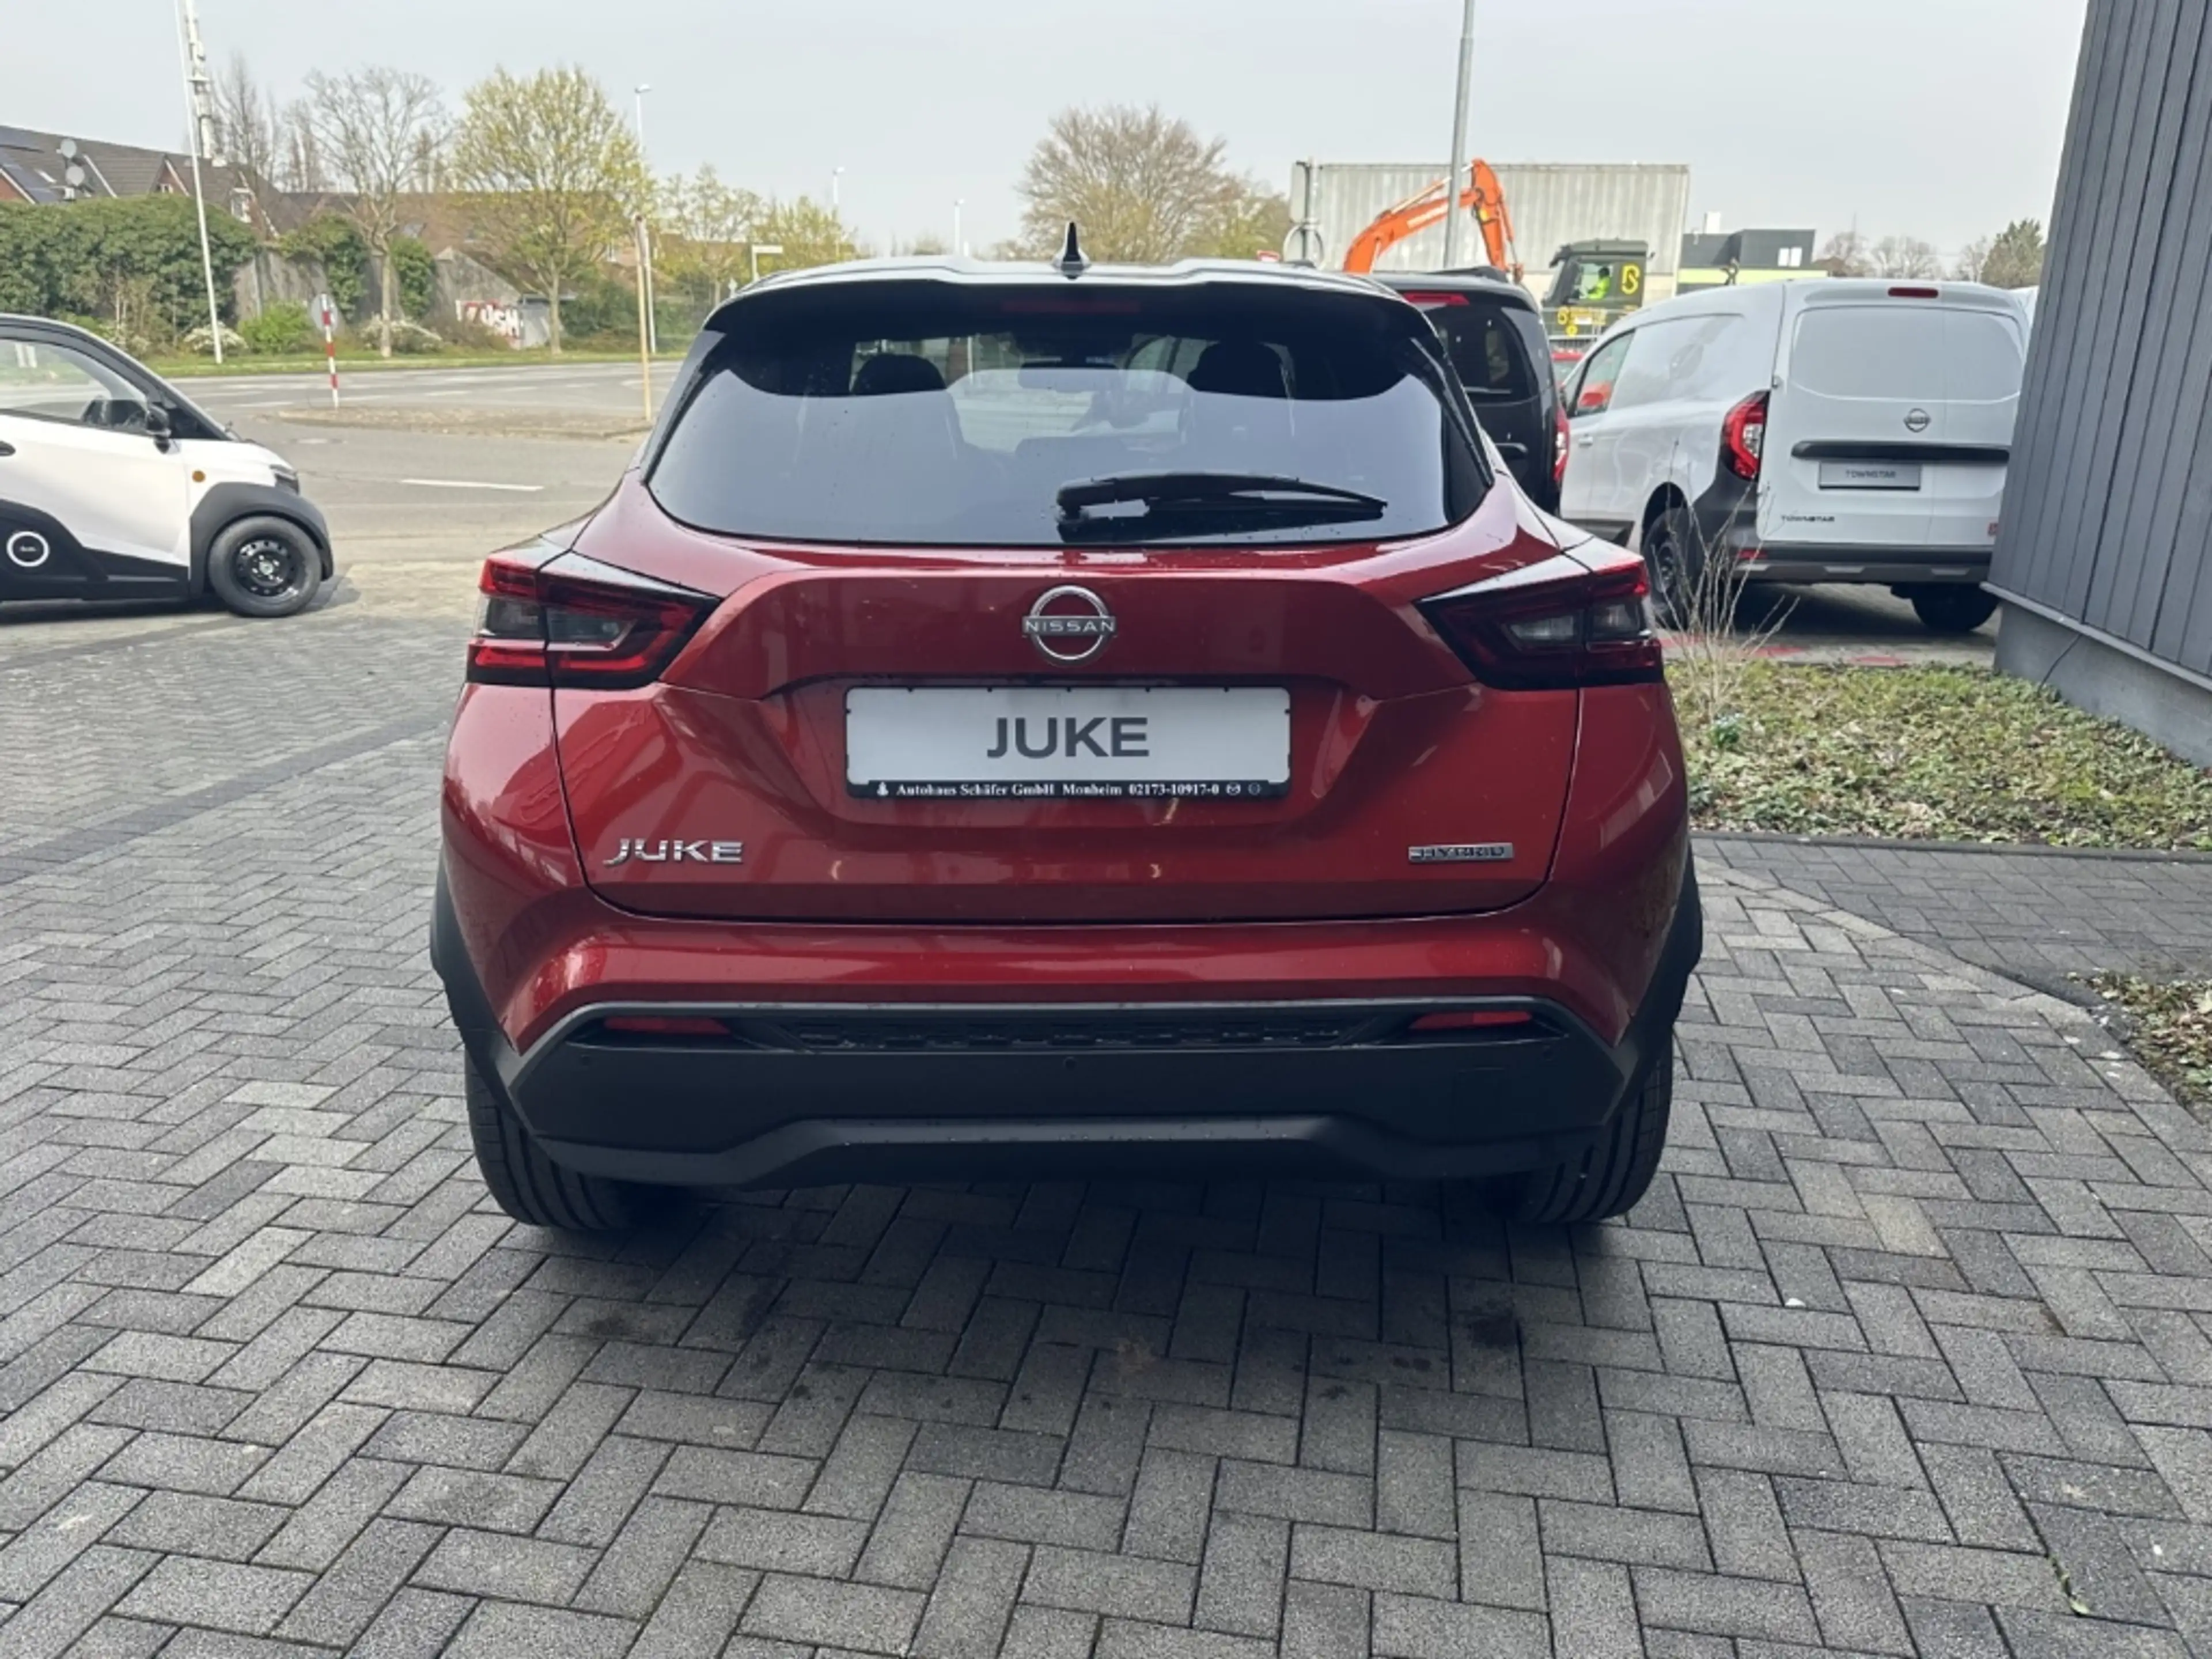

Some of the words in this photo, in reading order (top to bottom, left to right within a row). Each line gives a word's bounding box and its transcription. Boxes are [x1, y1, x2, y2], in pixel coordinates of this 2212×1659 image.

[1025, 620, 1115, 632] NISSAN
[987, 717, 1149, 759] JUKE
[896, 784, 957, 796] Autohaus
[959, 783, 1007, 796] Schäfer
[1011, 783, 1055, 796] GmbH
[1062, 783, 1122, 796] Monheim
[603, 838, 743, 865] JUKE
